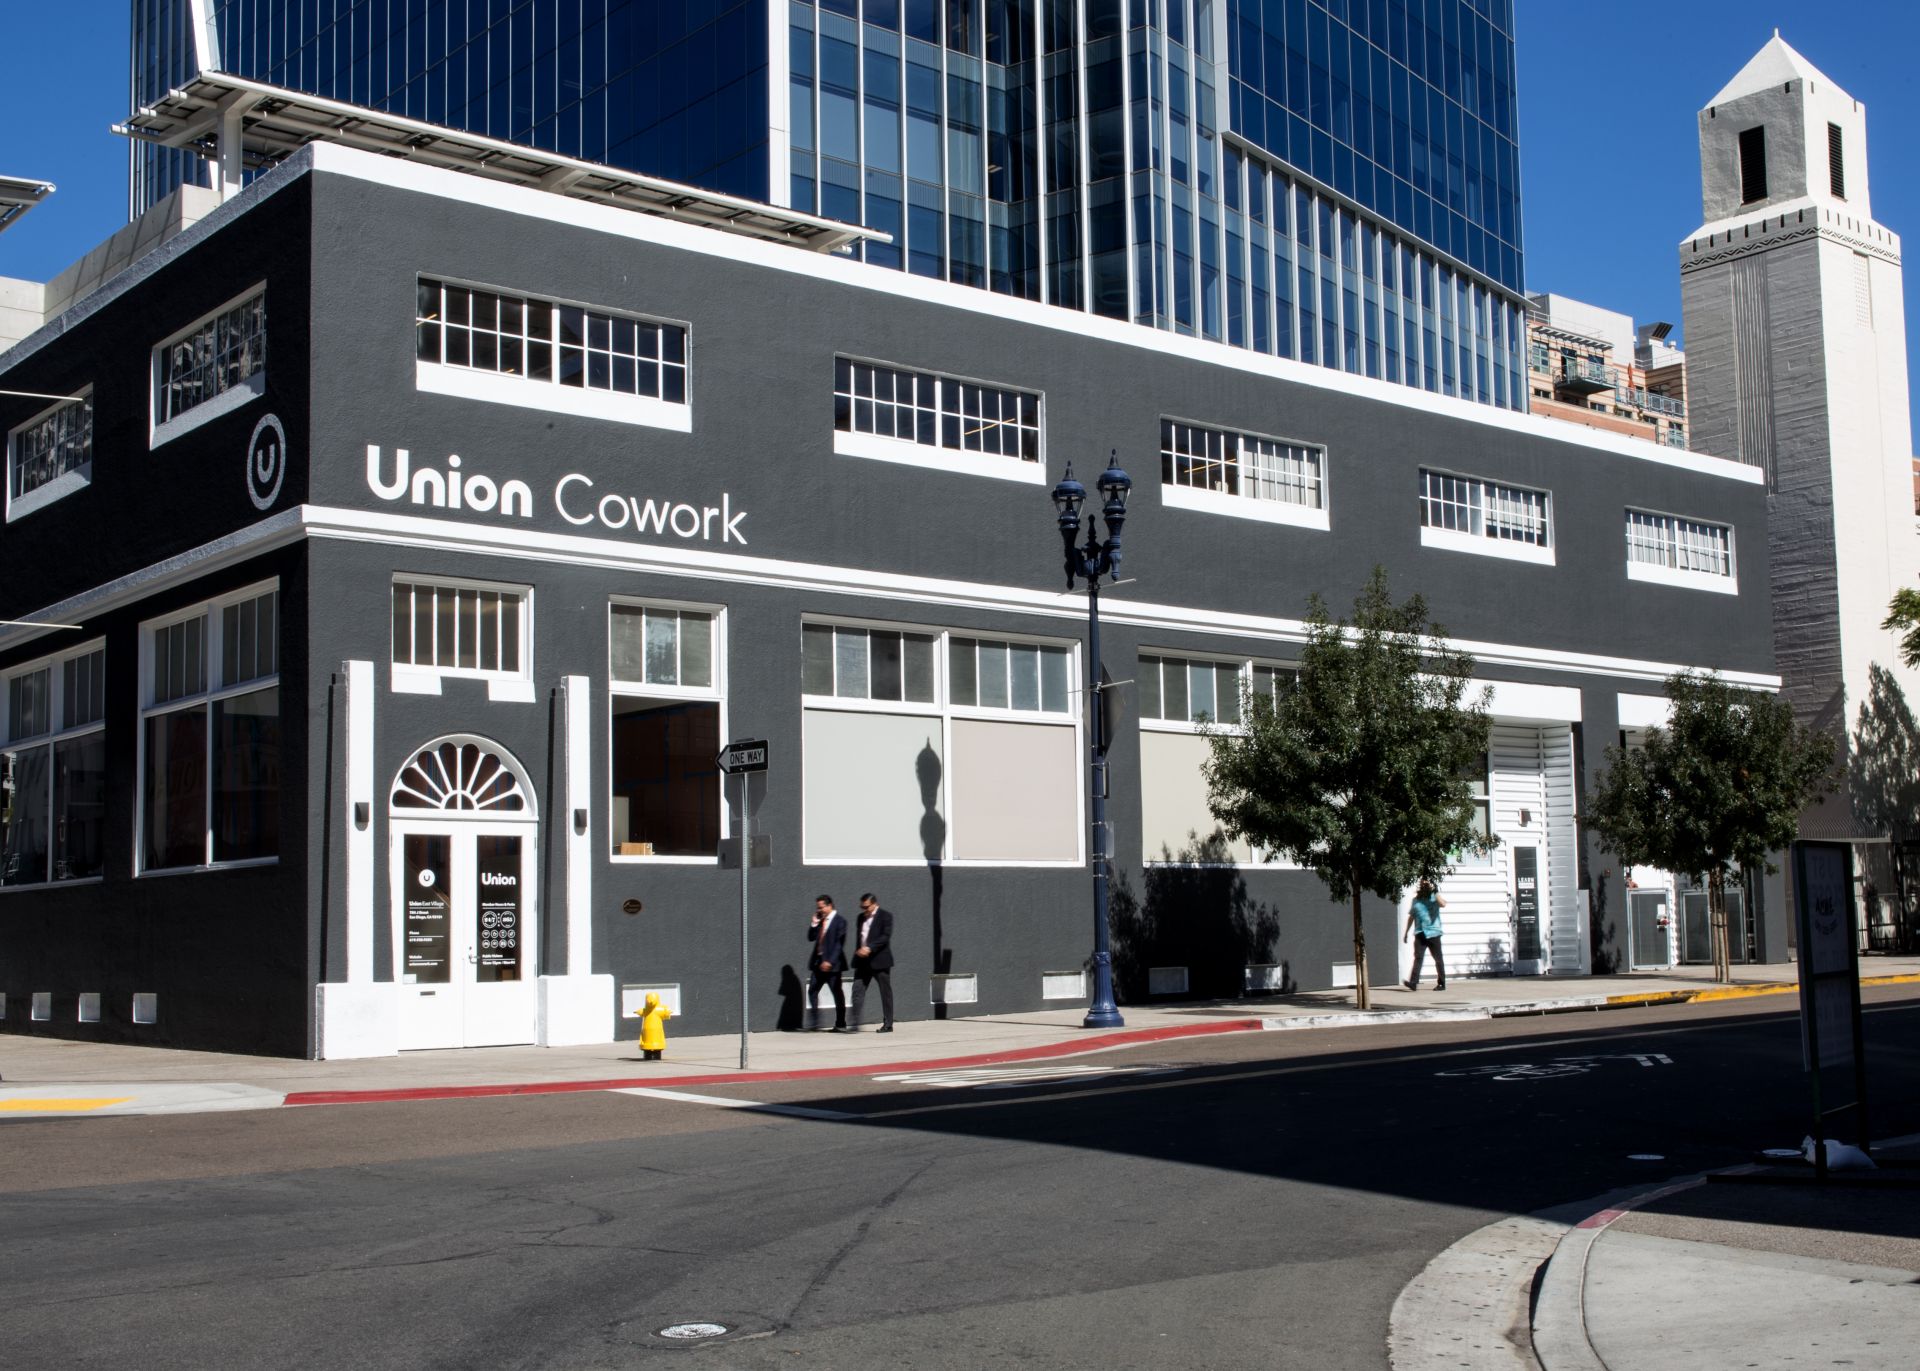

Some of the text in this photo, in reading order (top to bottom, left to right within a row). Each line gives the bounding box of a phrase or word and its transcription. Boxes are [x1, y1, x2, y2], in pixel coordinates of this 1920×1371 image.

[367, 444, 748, 545] Union Cowork
[730, 750, 763, 765] ONE WAY
[482, 872, 516, 885] Union
